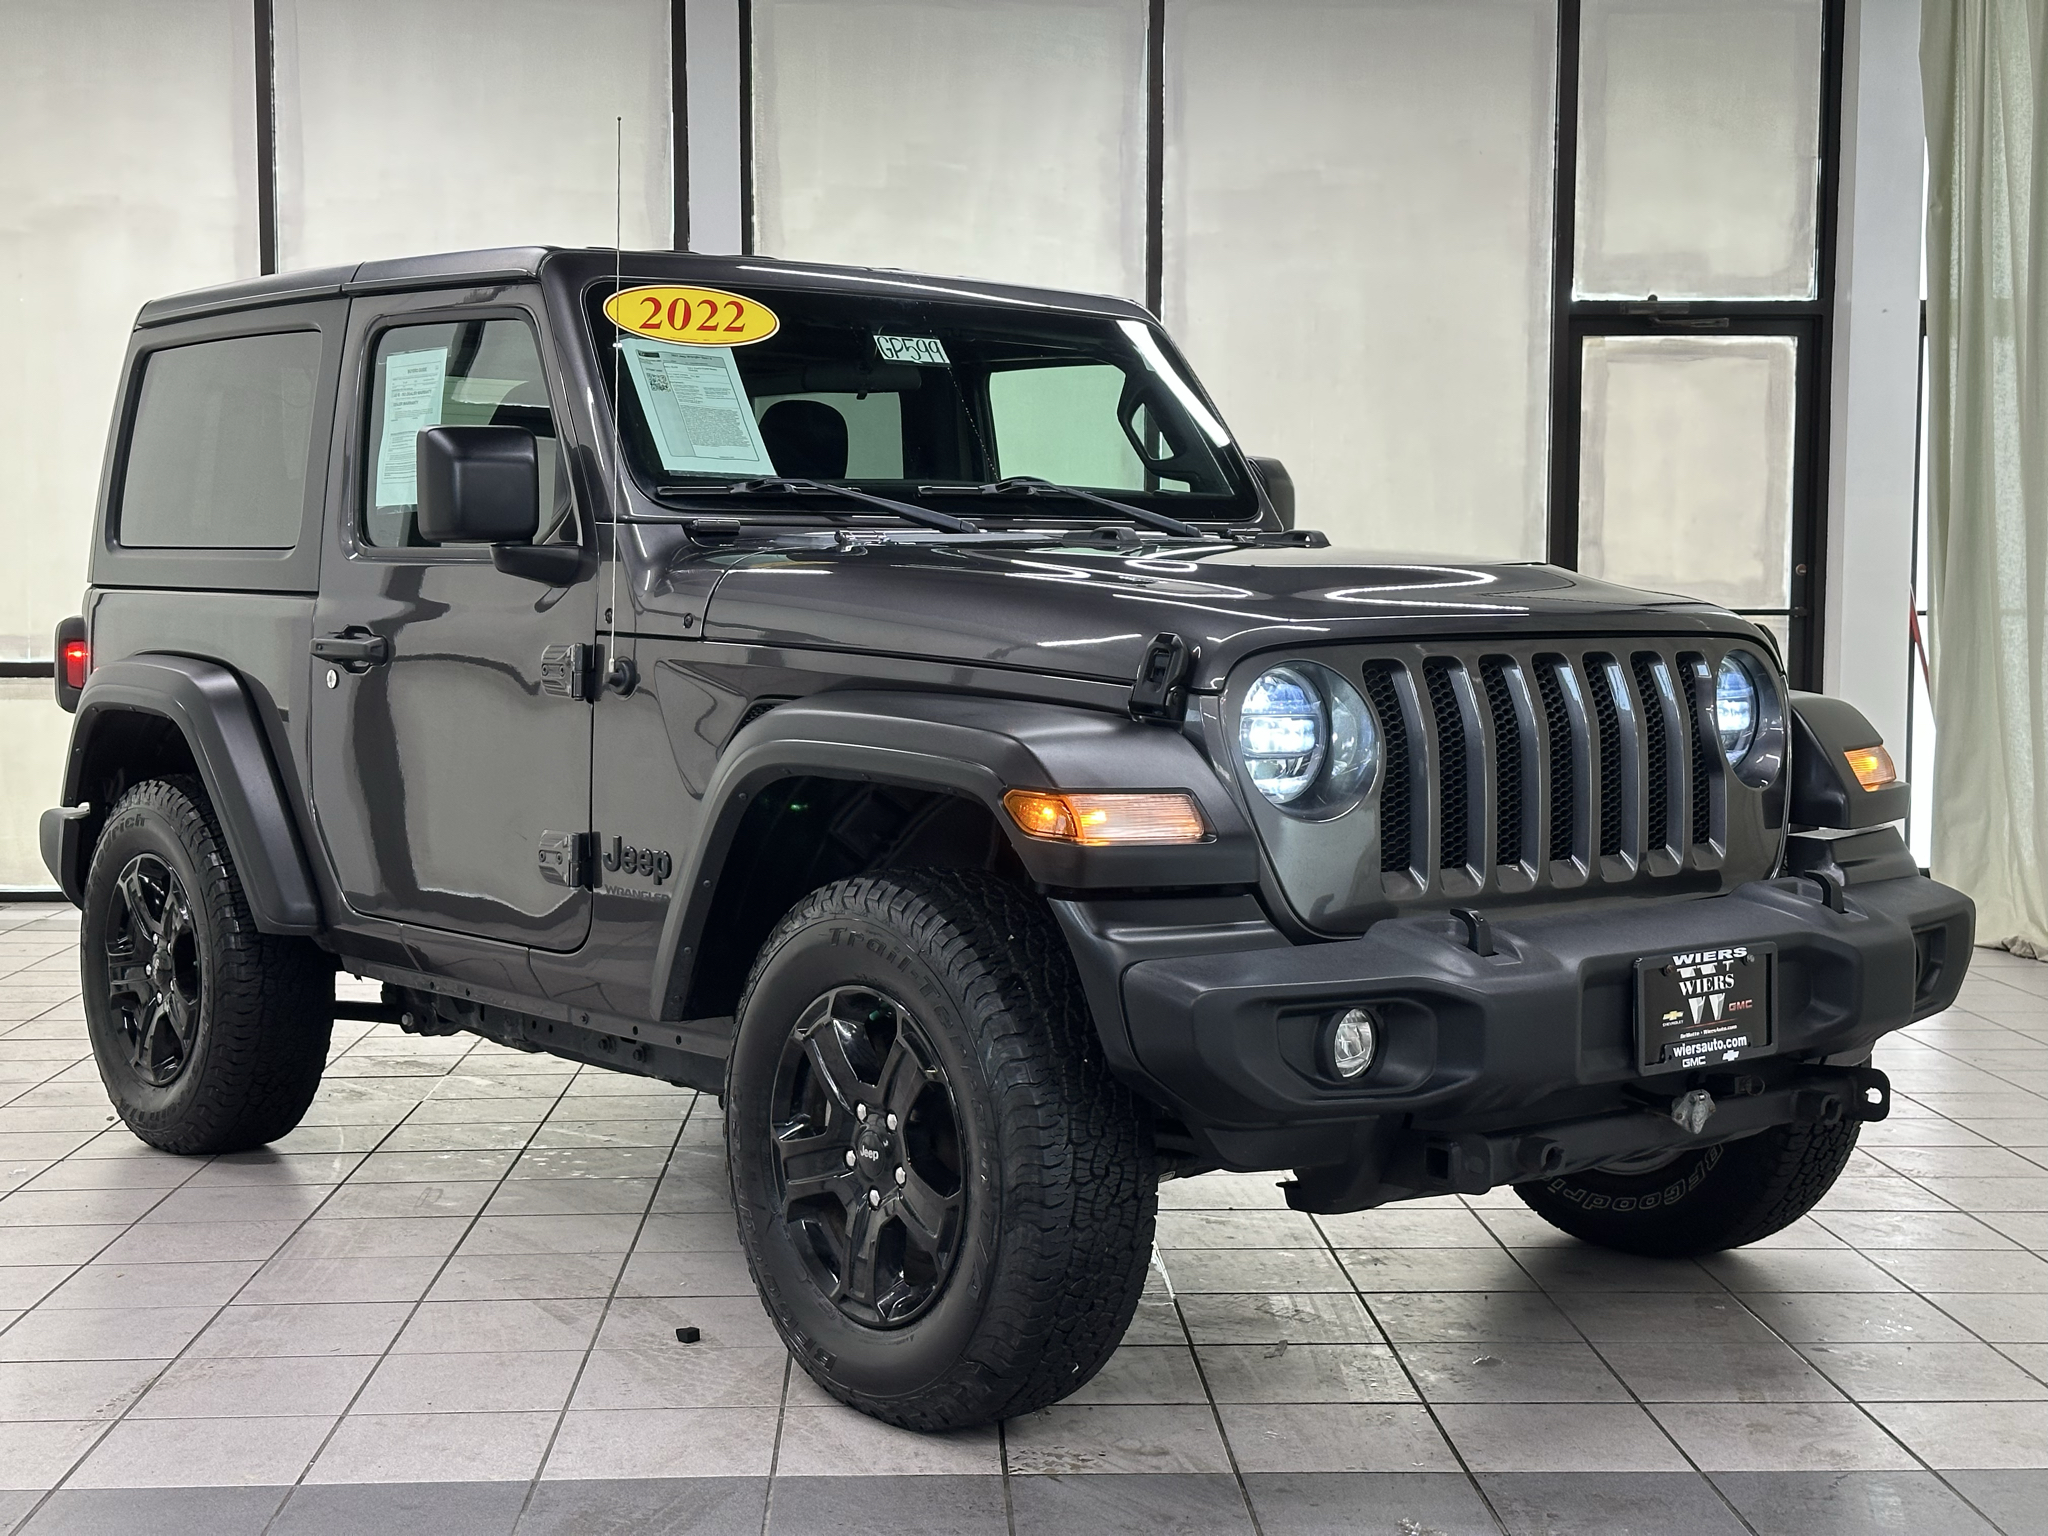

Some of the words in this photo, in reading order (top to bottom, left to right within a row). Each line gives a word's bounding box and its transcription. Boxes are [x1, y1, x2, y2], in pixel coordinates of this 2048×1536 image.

[639, 296, 746, 333] 2022
[878, 336, 947, 363] GP599
[602, 834, 671, 886] Jeep
[604, 883, 671, 901] WRANGLER
[1672, 946, 1748, 966] WIERS
[1678, 973, 1735, 996] WIERS
[1728, 999, 1753, 1012] GMC
[1673, 1035, 1748, 1058] wiersauto.com
[1682, 1055, 1706, 1068] GMC
[859, 1144, 879, 1162] Jeep
